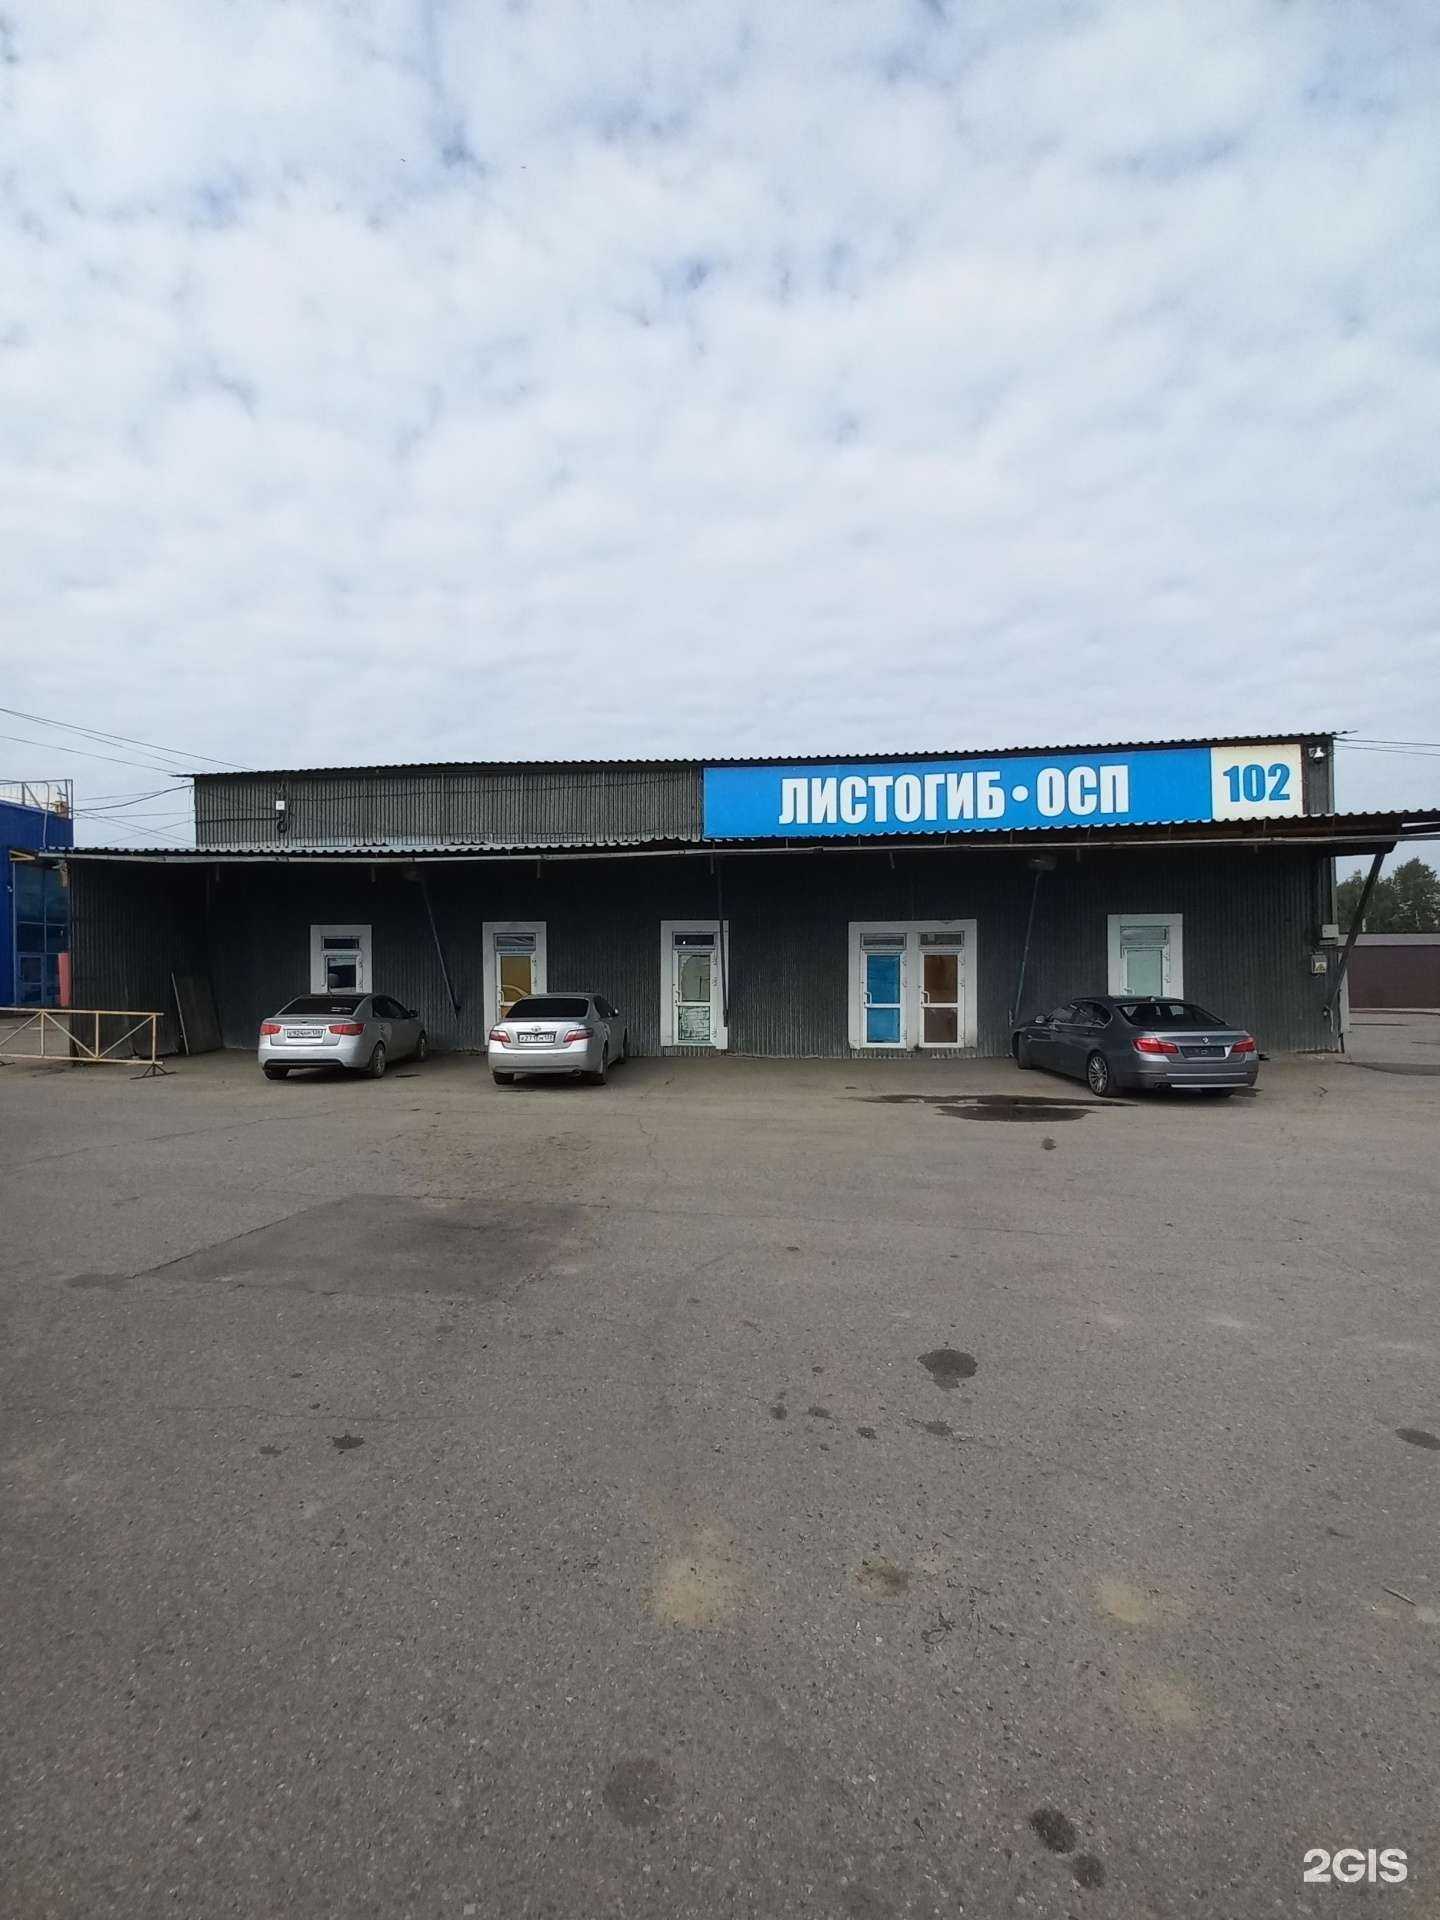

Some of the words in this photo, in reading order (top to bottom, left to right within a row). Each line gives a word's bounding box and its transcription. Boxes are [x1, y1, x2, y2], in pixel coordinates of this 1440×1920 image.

[779, 771, 1005, 824] ЛИСТОГИБ
[1036, 765, 1129, 817] ОСП
[1222, 763, 1290, 802] 102
